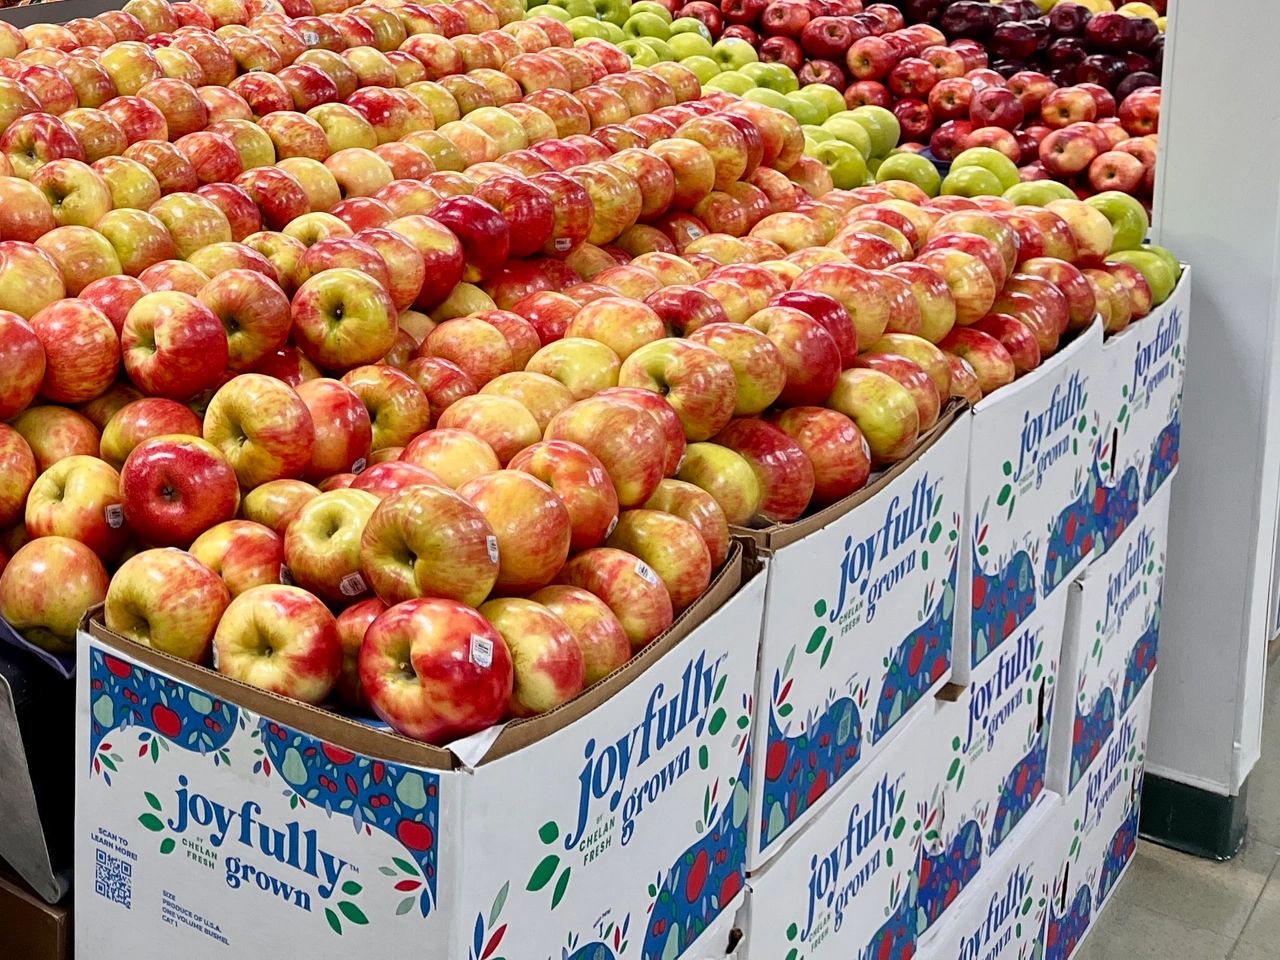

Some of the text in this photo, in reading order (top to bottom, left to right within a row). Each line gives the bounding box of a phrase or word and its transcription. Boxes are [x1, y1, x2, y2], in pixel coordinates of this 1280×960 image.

[1014, 369, 1086, 482] joyfully
[830, 471, 938, 623] joyfully
[866, 550, 916, 623] grown
[839, 600, 864, 625] CHELAN
[840, 615, 861, 638] FRESH
[963, 629, 1038, 754] joyfully
[565, 649, 721, 850] joyfully
[621, 746, 690, 846] grown
[91, 833, 113, 851] LEARN
[98, 827, 128, 847] SCAN TO
[168, 775, 348, 899] joyfully
[182, 838, 218, 860] CHELAN
[579, 816, 615, 852] CHELAN
[583, 836, 612, 866] FRESH
[187, 851, 215, 870] FRESH
[800, 772, 900, 942] joyfully
[163, 890, 176, 902] SIZE
[225, 857, 312, 913] grown
[834, 849, 880, 932] grown
[162, 898, 192, 918] PRODUCE
[193, 914, 203, 924] OF
[162, 915, 174, 926] CAT
[162, 907, 230, 946] ONE VOLUME BUSHEL
